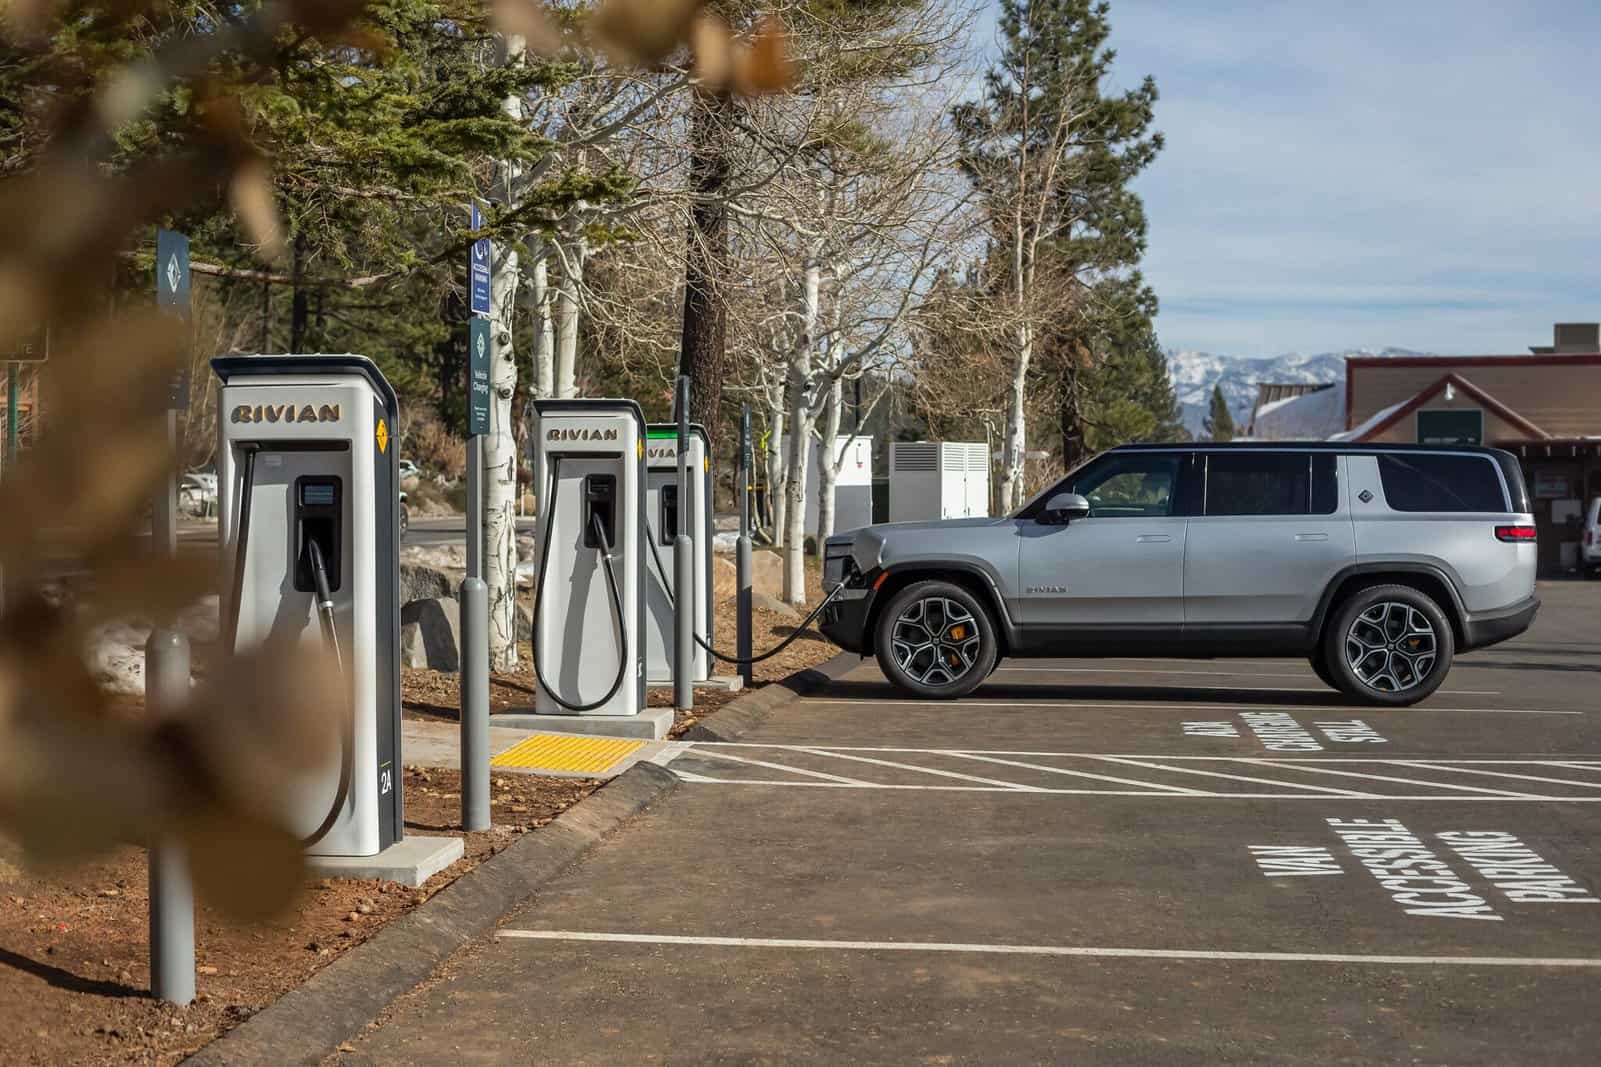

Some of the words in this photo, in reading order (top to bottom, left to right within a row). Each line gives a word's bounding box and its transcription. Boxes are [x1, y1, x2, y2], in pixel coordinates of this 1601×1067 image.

[231, 404, 340, 424] RIVIAN
[546, 428, 618, 441] RIVIAN
[1180, 721, 1241, 738] ADA
[1238, 711, 1324, 752] CHARGING
[1312, 719, 1389, 744] STALL
[381, 769, 392, 795] 2A
[1247, 845, 1345, 876] VAN
[1325, 818, 1504, 921] ACCESSIBLE
[1434, 831, 1601, 903] PARKING
